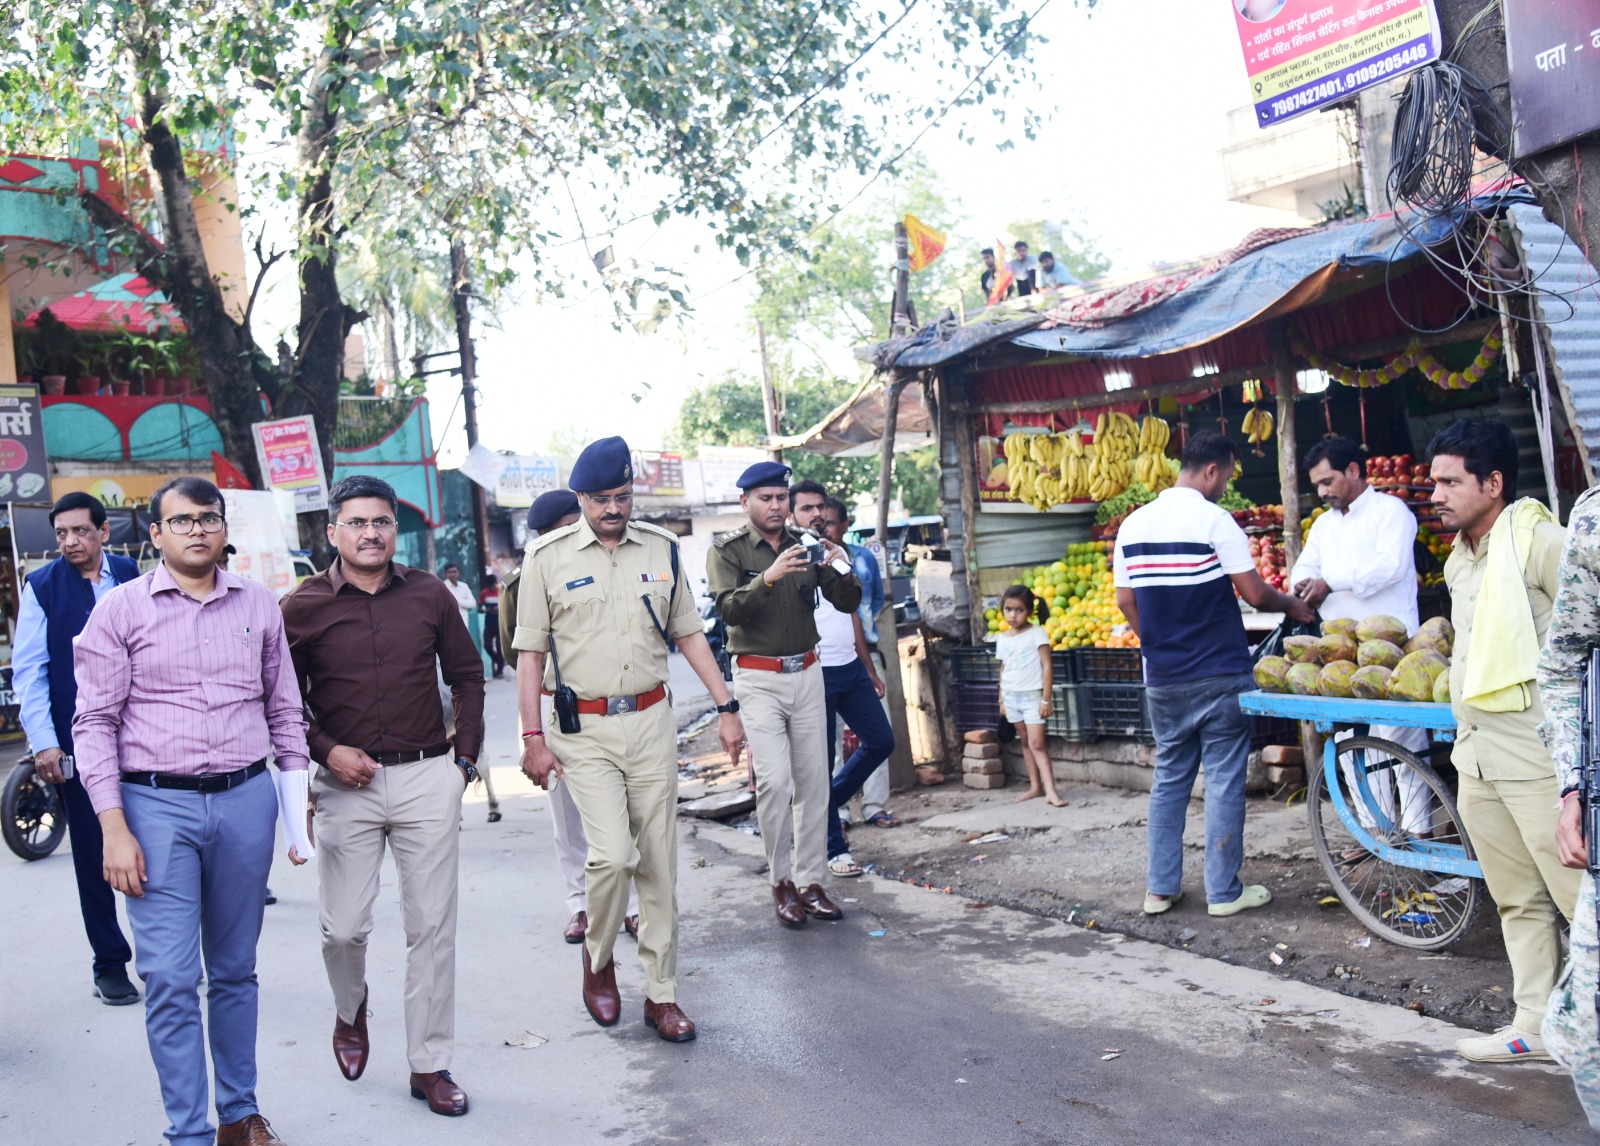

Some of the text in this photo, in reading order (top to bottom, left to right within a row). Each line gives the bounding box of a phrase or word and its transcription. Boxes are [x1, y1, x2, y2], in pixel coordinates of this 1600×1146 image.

[1257, 47, 1270, 61] दर्द
[1271, 41, 1290, 56] रहित
[1292, 31, 1316, 48] सिंगल
[1357, 3, 1384, 21] कैनाल
[1273, 25, 1285, 36] का
[1309, 5, 1334, 23] इलाज
[1345, 43, 1427, 88] 9109205446
[1535, 43, 1567, 72] पता
